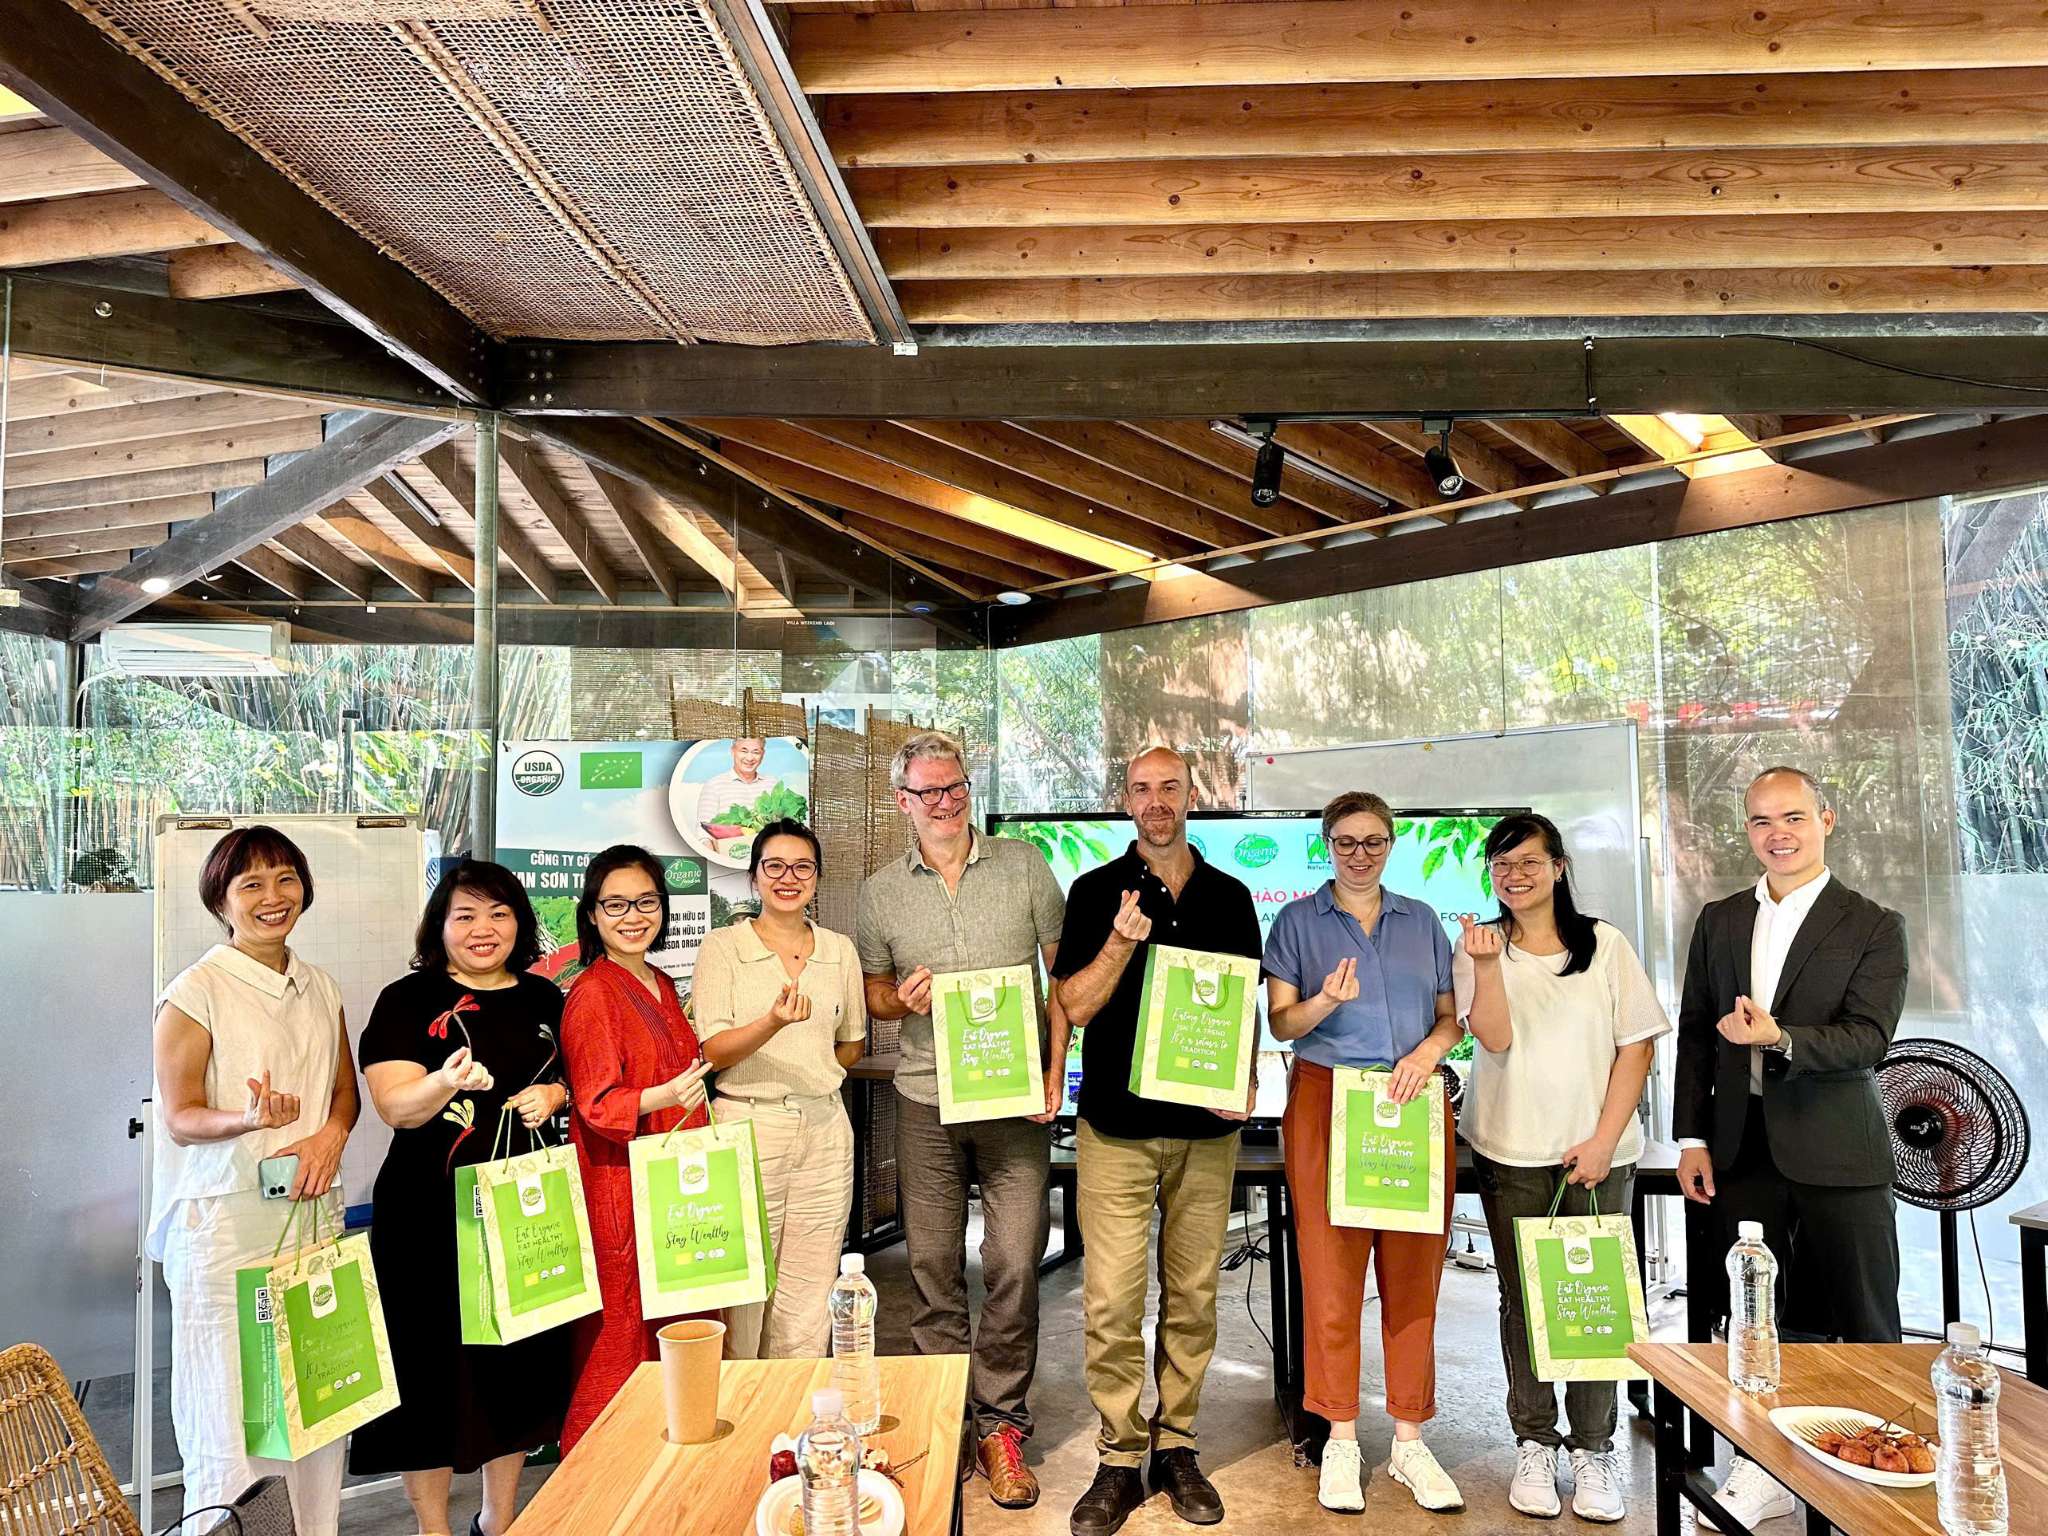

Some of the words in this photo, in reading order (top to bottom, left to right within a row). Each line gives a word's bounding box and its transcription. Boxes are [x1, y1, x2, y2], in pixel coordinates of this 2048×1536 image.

[524, 762, 553, 772] USDA
[520, 774, 557, 784] ORGANIC
[530, 850, 559, 866] CÔNG
[561, 854, 575, 867] TY
[540, 871, 569, 889] SƠN
[664, 869, 702, 881] Organic
[514, 1224, 529, 1243] Eat
[665, 1231, 687, 1249] Stay
[690, 1223, 729, 1245] Wealthy
[1556, 1280, 1574, 1296] Eat
[1575, 1279, 1609, 1296] Organic
[1574, 1295, 1611, 1303] HEALTHY
[1556, 1303, 1577, 1321] Stay
